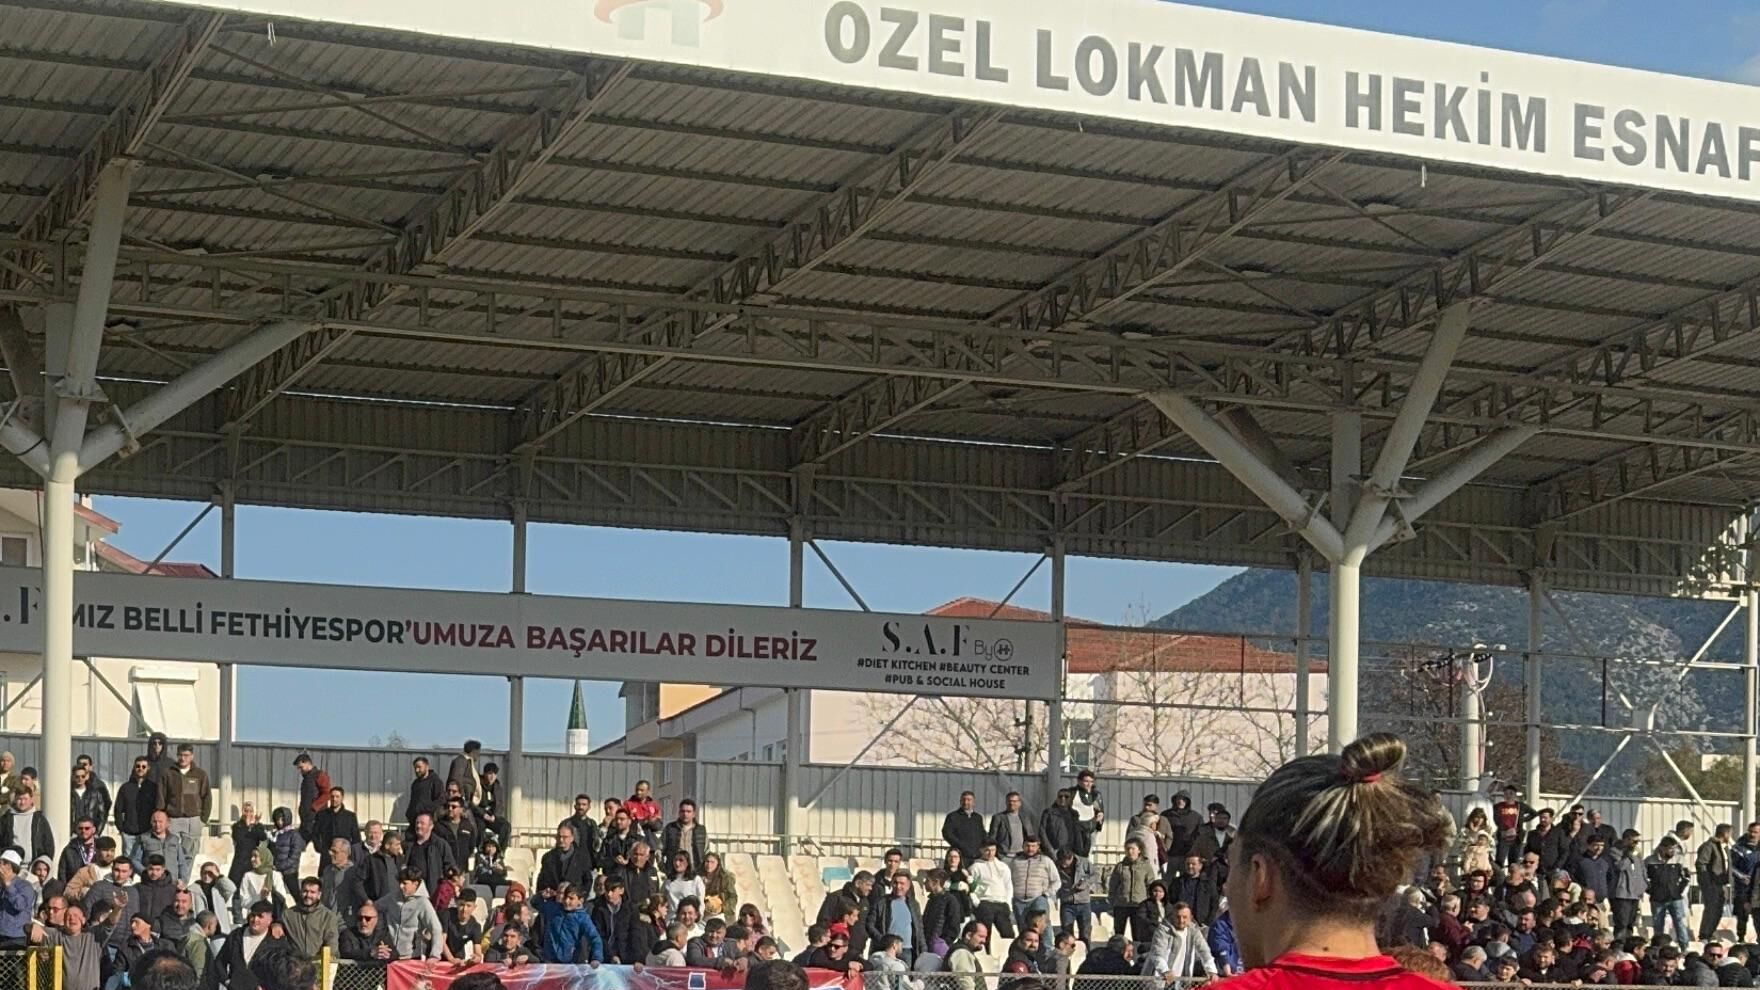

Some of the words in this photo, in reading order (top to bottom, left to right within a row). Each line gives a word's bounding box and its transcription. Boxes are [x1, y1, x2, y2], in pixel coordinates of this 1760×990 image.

[1036, 29, 1316, 123] LOKMAN
[1345, 71, 1546, 153] HEKİM
[1574, 103, 1760, 181] ESNAF
[73, 604, 115, 630] MIZ
[124, 602, 203, 634] BELLİ
[211, 607, 515, 649] FETHİYESPOR'UMUZA
[526, 625, 696, 658] BAŞARILAR
[705, 628, 818, 661] DİLERİZ
[969, 677, 1006, 690] HOUSE
[990, 664, 1030, 676] CENTER
